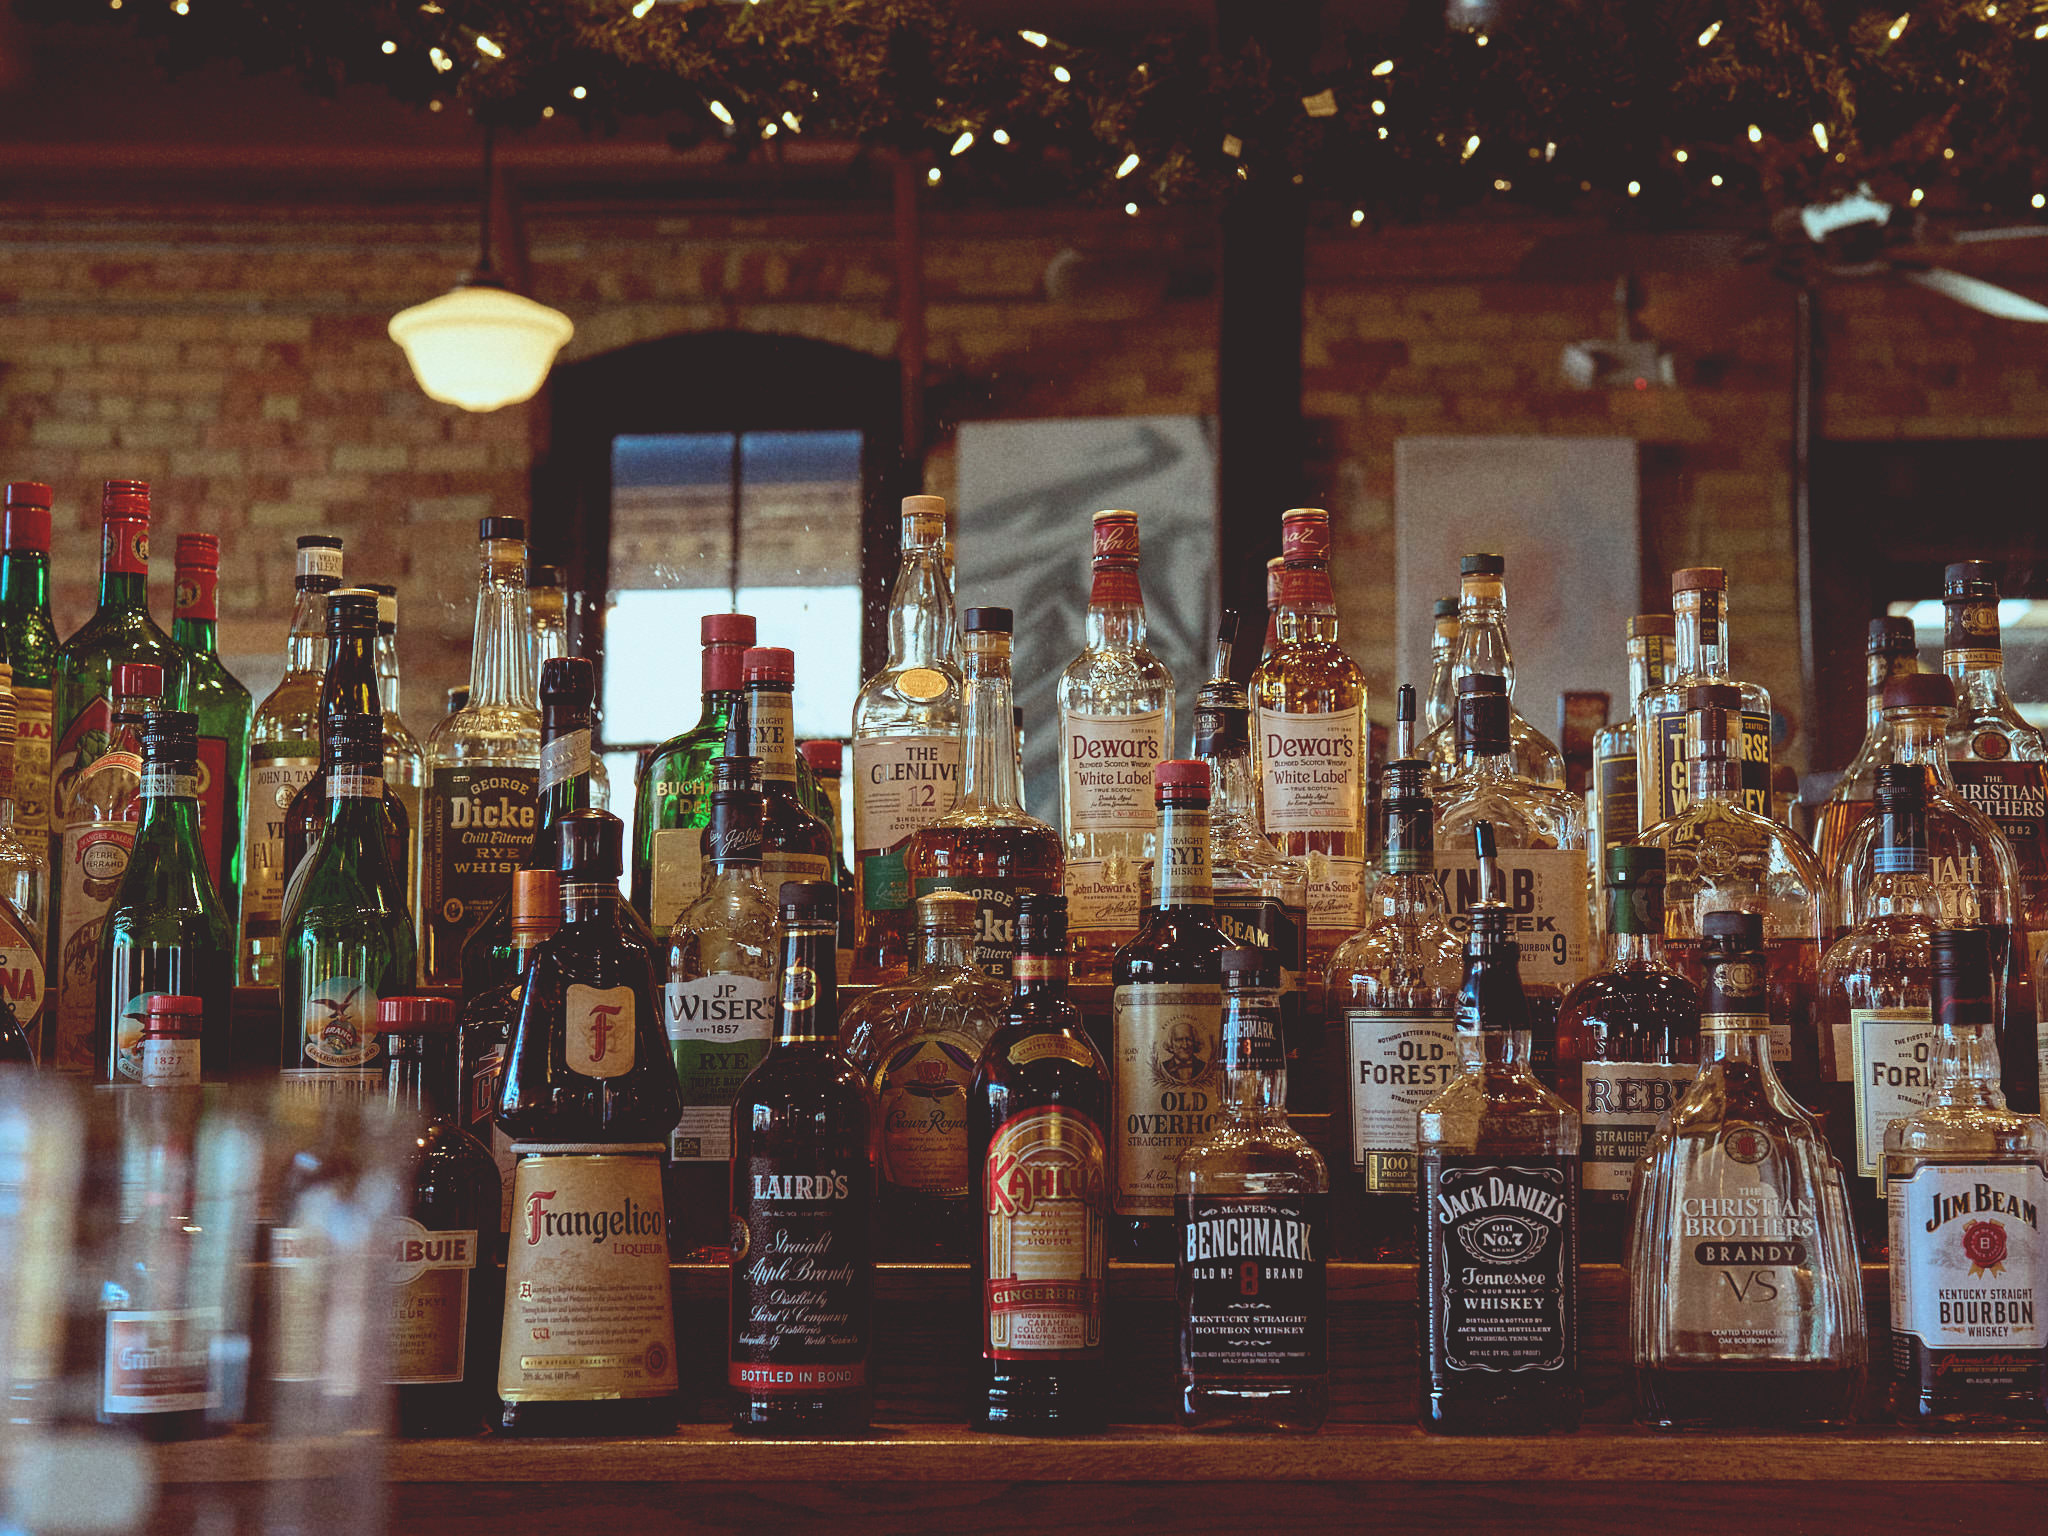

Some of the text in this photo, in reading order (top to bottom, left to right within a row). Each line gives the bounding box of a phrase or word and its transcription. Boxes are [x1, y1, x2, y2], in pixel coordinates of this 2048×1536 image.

[1072, 735, 1159, 760] Dewar's
[1267, 733, 1355, 758] Dewar's
[905, 747, 938, 761] THE
[1104, 760, 1129, 768] SCOTCH
[1300, 759, 1326, 767] SCOTCH
[257, 770, 280, 785] JOHN
[1983, 775, 2003, 783] THE
[470, 777, 530, 796] GEORGE
[1956, 784, 2045, 801] HRISTIAN
[908, 784, 936, 807] 12
[461, 831, 534, 845] Chill Filtered
[2002, 825, 2032, 836] 1882
[475, 847, 520, 859] RYE
[1164, 847, 1205, 866] RYE
[1073, 883, 1093, 896] John
[1093, 883, 1124, 893] Dewar
[1220, 914, 1270, 948] BEAM
[1552, 933, 1567, 966] 9
[711, 1024, 739, 1034] 1857
[1402, 1030, 1424, 1038] BETTER
[1399, 1040, 1444, 1061] OLD
[154, 1056, 183, 1065] 1827
[698, 1052, 749, 1070] RYE
[1161, 1091, 1208, 1112] OLD
[887, 1110, 927, 1134] Crown
[1127, 1136, 1173, 1147] STRAIGHT
[1595, 1130, 1649, 1142] STRAIGHT
[1595, 1145, 1616, 1157] RYE
[1381, 1156, 1409, 1170] 100
[753, 1169, 849, 1200] LAIRD'S
[1437, 1176, 1568, 1225] JACK DANIEL'S
[1682, 1198, 1815, 1218] CHRISTIAN
[1926, 1183, 2038, 1233] JIM BEAM
[524, 1190, 661, 1246] Frangelico
[1031, 1228, 1069, 1236] COFFEE
[1491, 1224, 1513, 1232] Old
[1685, 1218, 1815, 1237] BROTHERS
[764, 1228, 833, 1258] Straight
[1028, 1238, 1072, 1246] LIQUEUR
[1186, 1218, 1313, 1262] BENCHMARK
[613, 1242, 663, 1258] LIQUEUR
[1705, 1246, 1796, 1262] BRANDY
[743, 1256, 855, 1288] Apple Brandy
[1193, 1261, 1304, 1296] OLD 8 BRAND
[1461, 1267, 1546, 1286] Tennessee
[1720, 1270, 1778, 1303] VS
[1939, 1288, 2033, 1300] KENTUCKY STRAIGHT
[769, 1288, 828, 1308] Distilled by
[1463, 1297, 1545, 1310] WHISKEY
[748, 1303, 782, 1322] Laird
[791, 1305, 849, 1326] Company
[1191, 1315, 1308, 1324] KENTUCKY STRAIGHT
[1939, 1301, 2034, 1325] BOURBON
[1017, 1326, 1080, 1334] COLOR ADDED
[1027, 1319, 1070, 1327] CARAMEL
[1195, 1326, 1305, 1335] BOURBON WHISKEY
[1740, 1329, 1751, 1337] TO
[1967, 1326, 2009, 1338] WHISKEY
[1733, 1337, 1766, 1345] BOURBON
[741, 1369, 852, 1383] BOTTLED IN BOND
